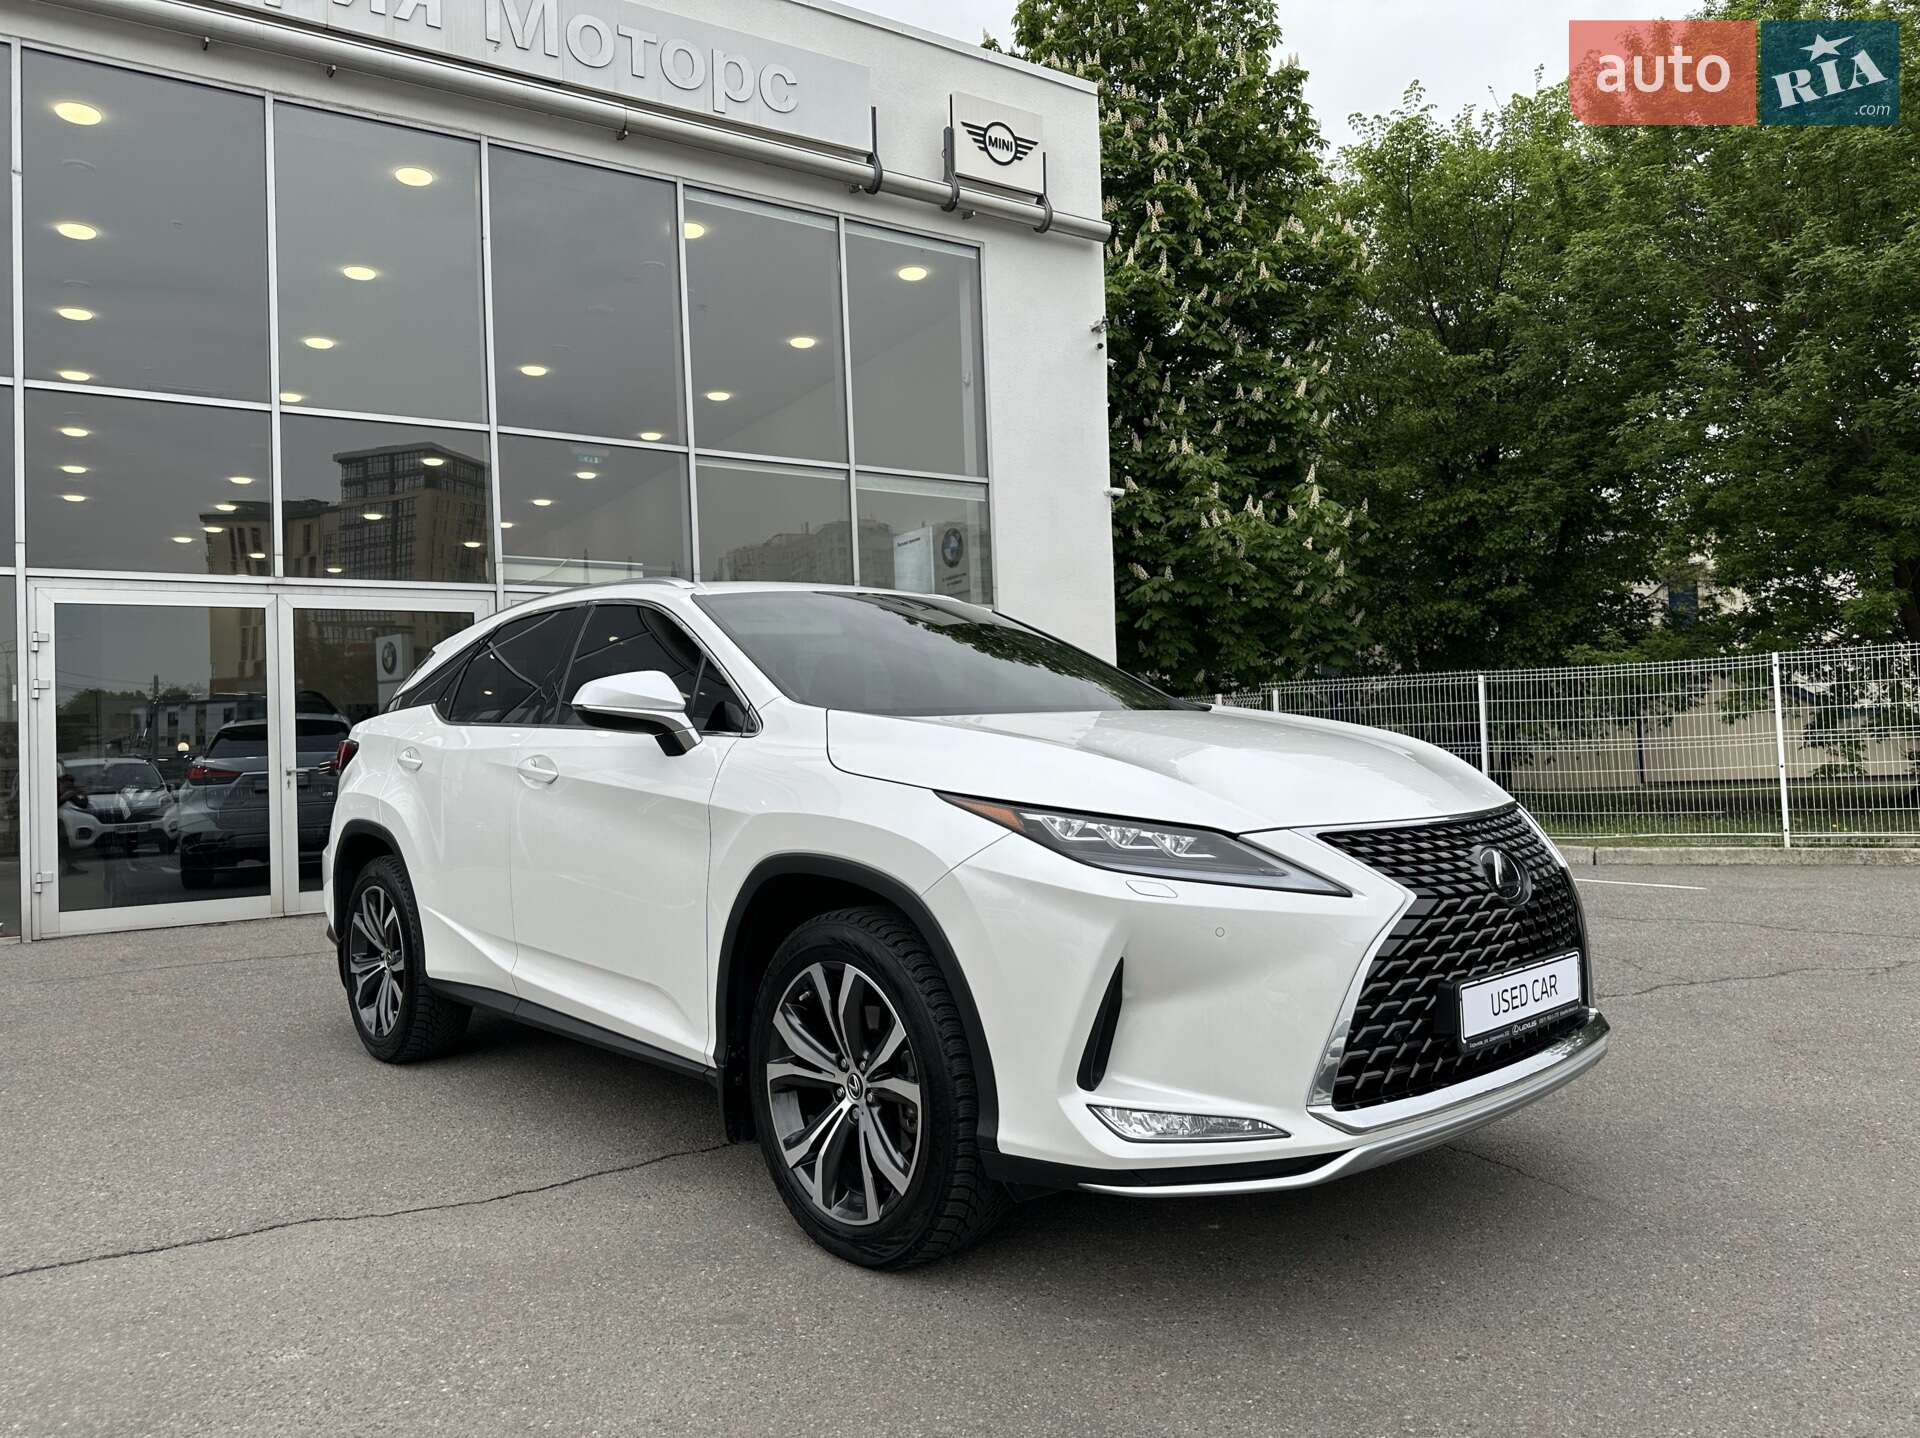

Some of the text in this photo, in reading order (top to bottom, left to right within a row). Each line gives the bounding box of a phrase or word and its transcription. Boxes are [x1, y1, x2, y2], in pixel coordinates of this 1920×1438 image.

[485, 0, 799, 114] Моторс
[988, 135, 1013, 152] MINI
[1490, 983, 1529, 1017] USED
[1531, 974, 1559, 1003] CAR
